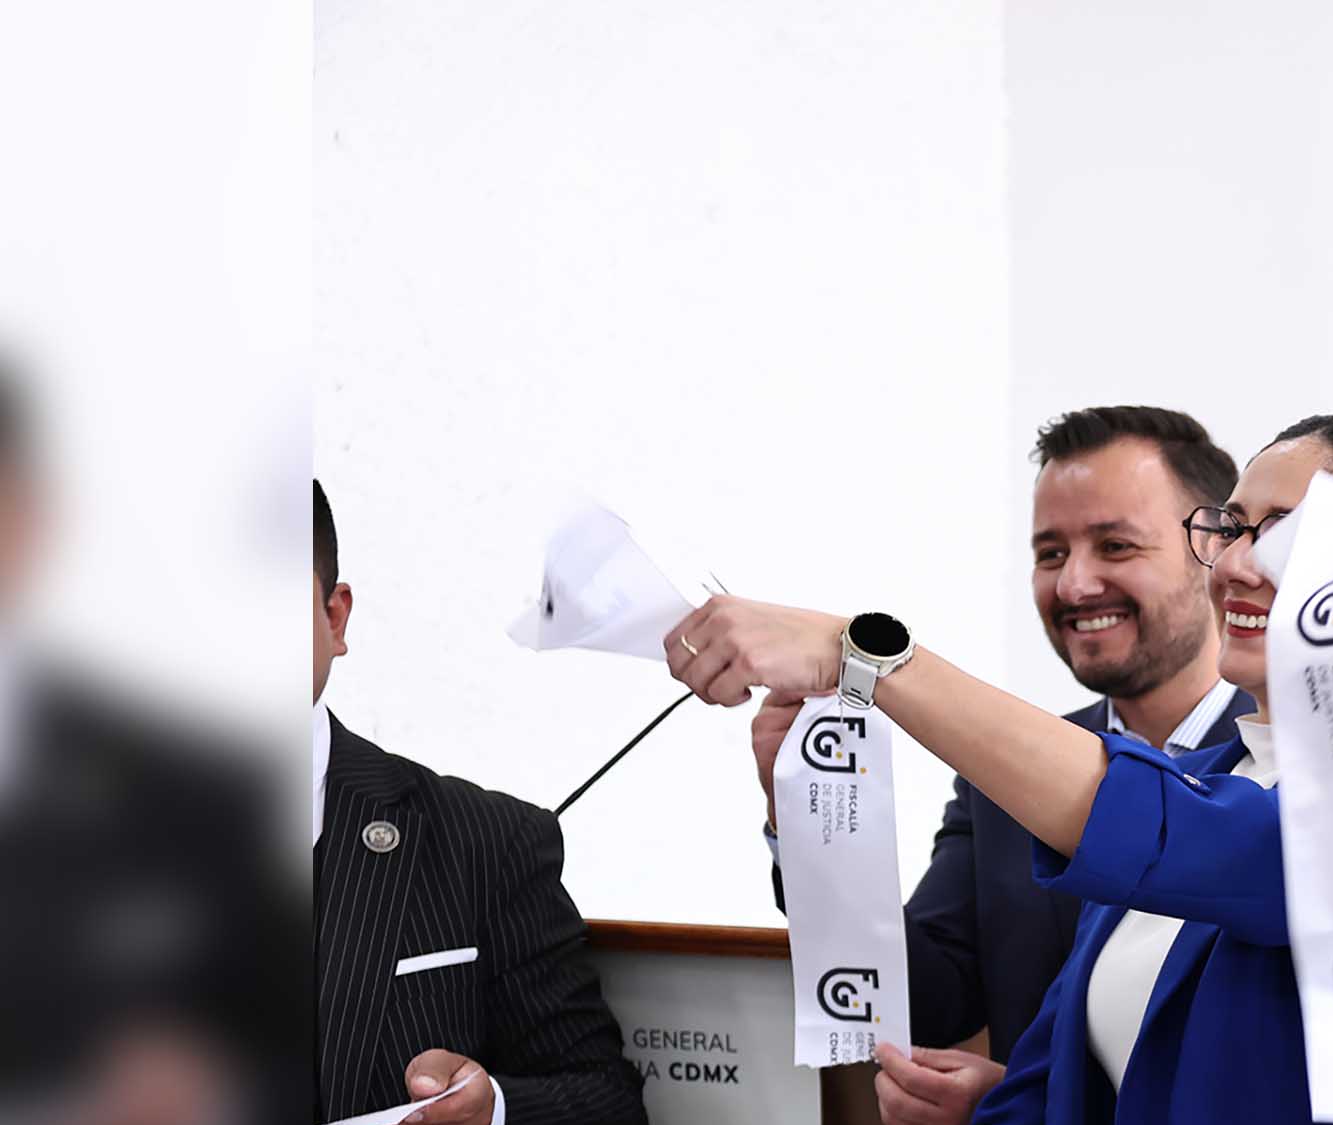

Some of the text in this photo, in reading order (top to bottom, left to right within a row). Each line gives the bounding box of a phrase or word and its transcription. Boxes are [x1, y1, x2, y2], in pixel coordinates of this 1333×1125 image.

[809, 782, 818, 815] CDMX
[632, 1028, 737, 1053] GENERAL
[668, 1061, 739, 1084] CDMX
